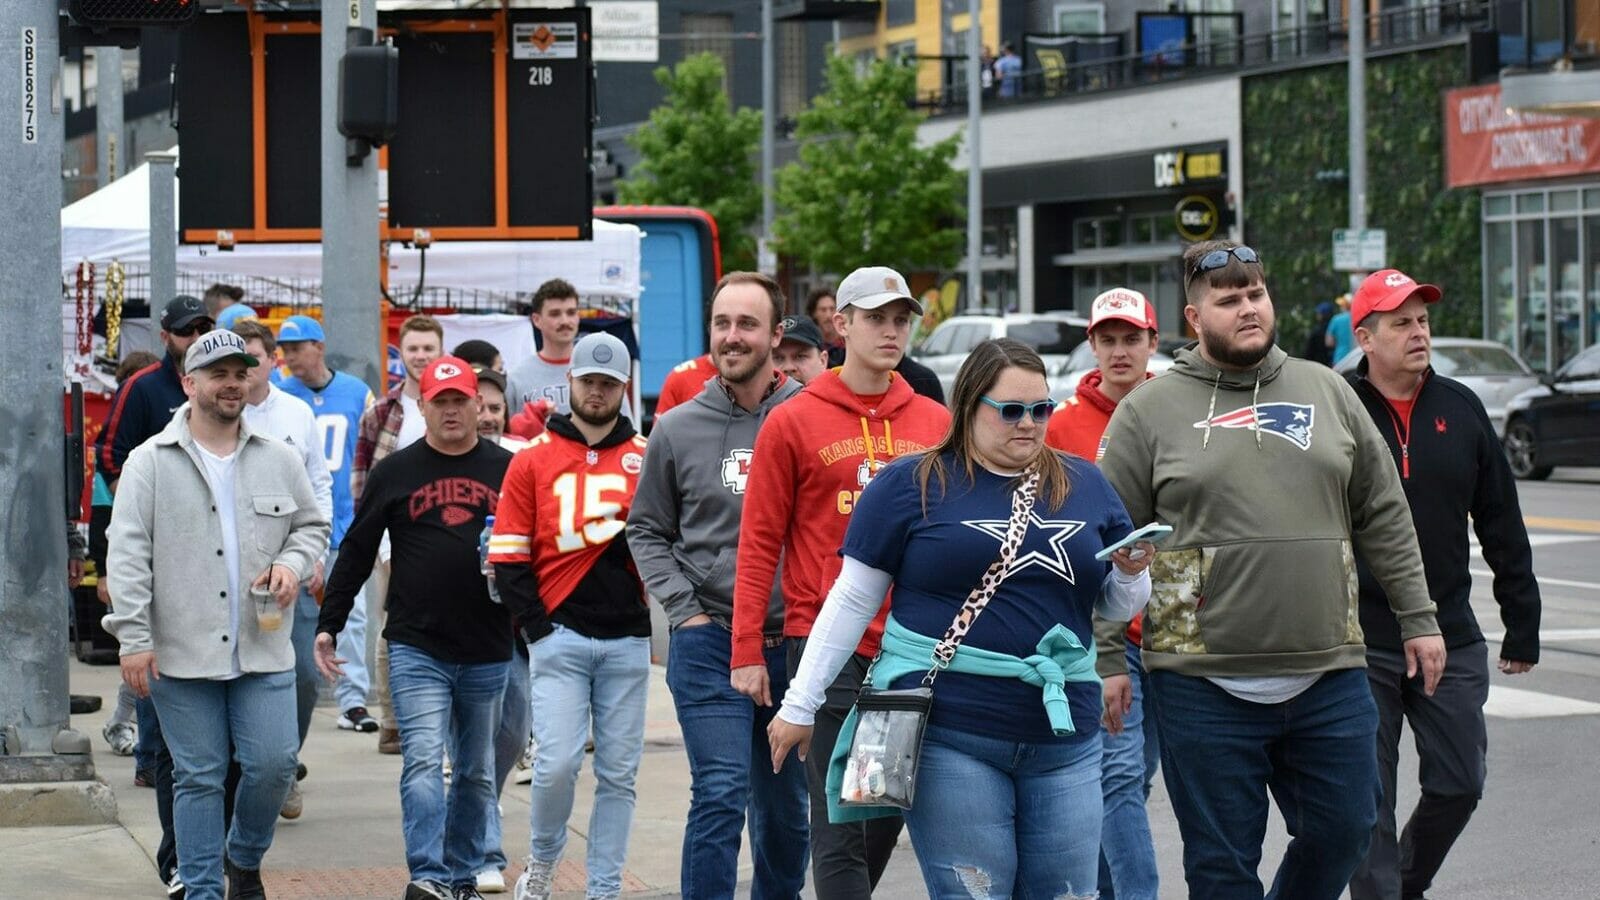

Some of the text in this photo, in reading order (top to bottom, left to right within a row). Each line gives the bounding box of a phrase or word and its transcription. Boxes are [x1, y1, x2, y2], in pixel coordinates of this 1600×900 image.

[24, 28, 34, 141] SBE8275
[529, 66, 552, 85] 218
[553, 472, 627, 553] 15
